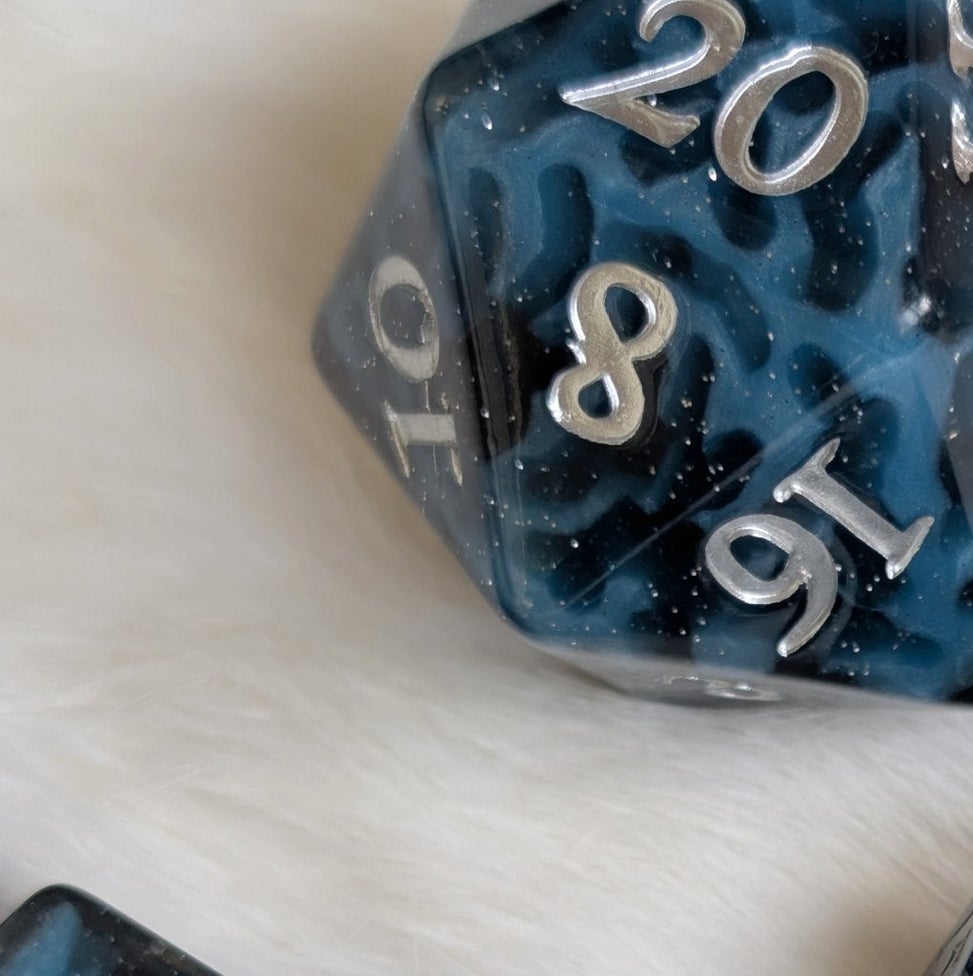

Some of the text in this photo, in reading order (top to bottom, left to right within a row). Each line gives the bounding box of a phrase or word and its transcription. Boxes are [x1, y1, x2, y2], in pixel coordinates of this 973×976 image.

[559, 0, 868, 197] 20
[368, 255, 463, 487] 10
[547, 262, 678, 445] 8
